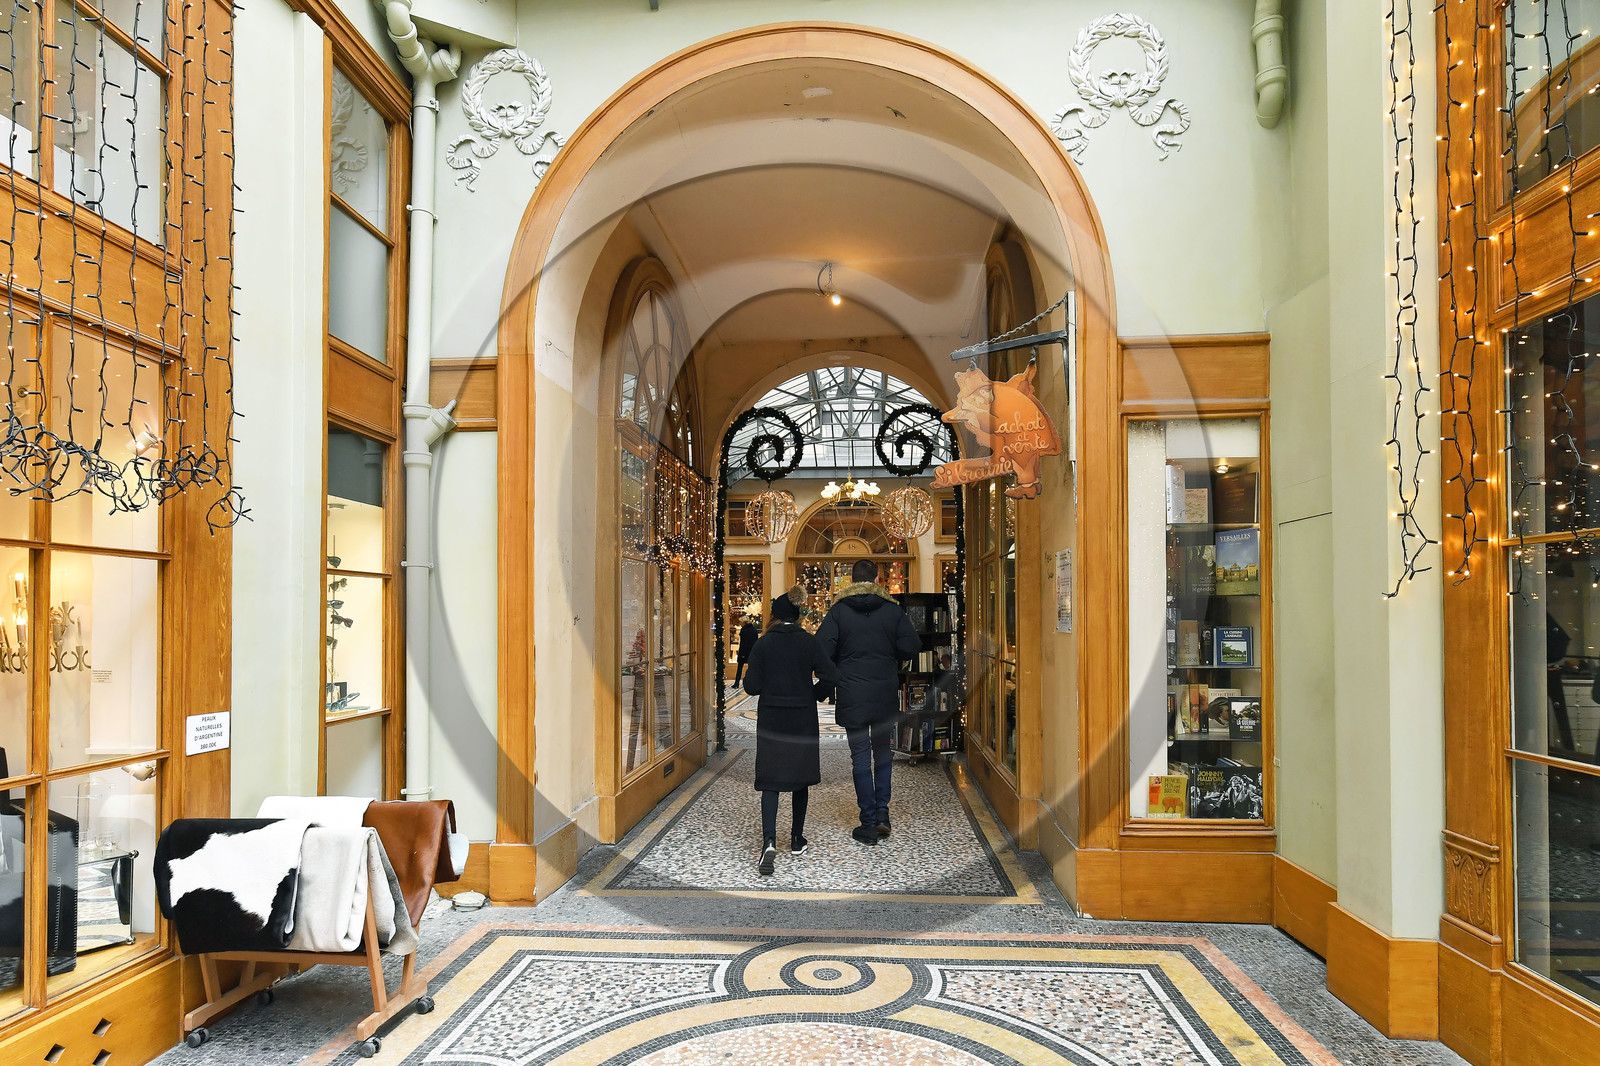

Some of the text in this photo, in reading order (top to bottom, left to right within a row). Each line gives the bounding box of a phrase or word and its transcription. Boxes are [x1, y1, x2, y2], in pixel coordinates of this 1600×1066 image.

[995, 410, 1046, 435] achat
[1017, 431, 1030, 443] et
[1003, 433, 1050, 454] vente
[929, 456, 1014, 490] Librairie
[1220, 533, 1251, 542] VERSAILLES
[195, 722, 223, 732] NATURELLES
[194, 731, 223, 742] D'ARGENTINE
